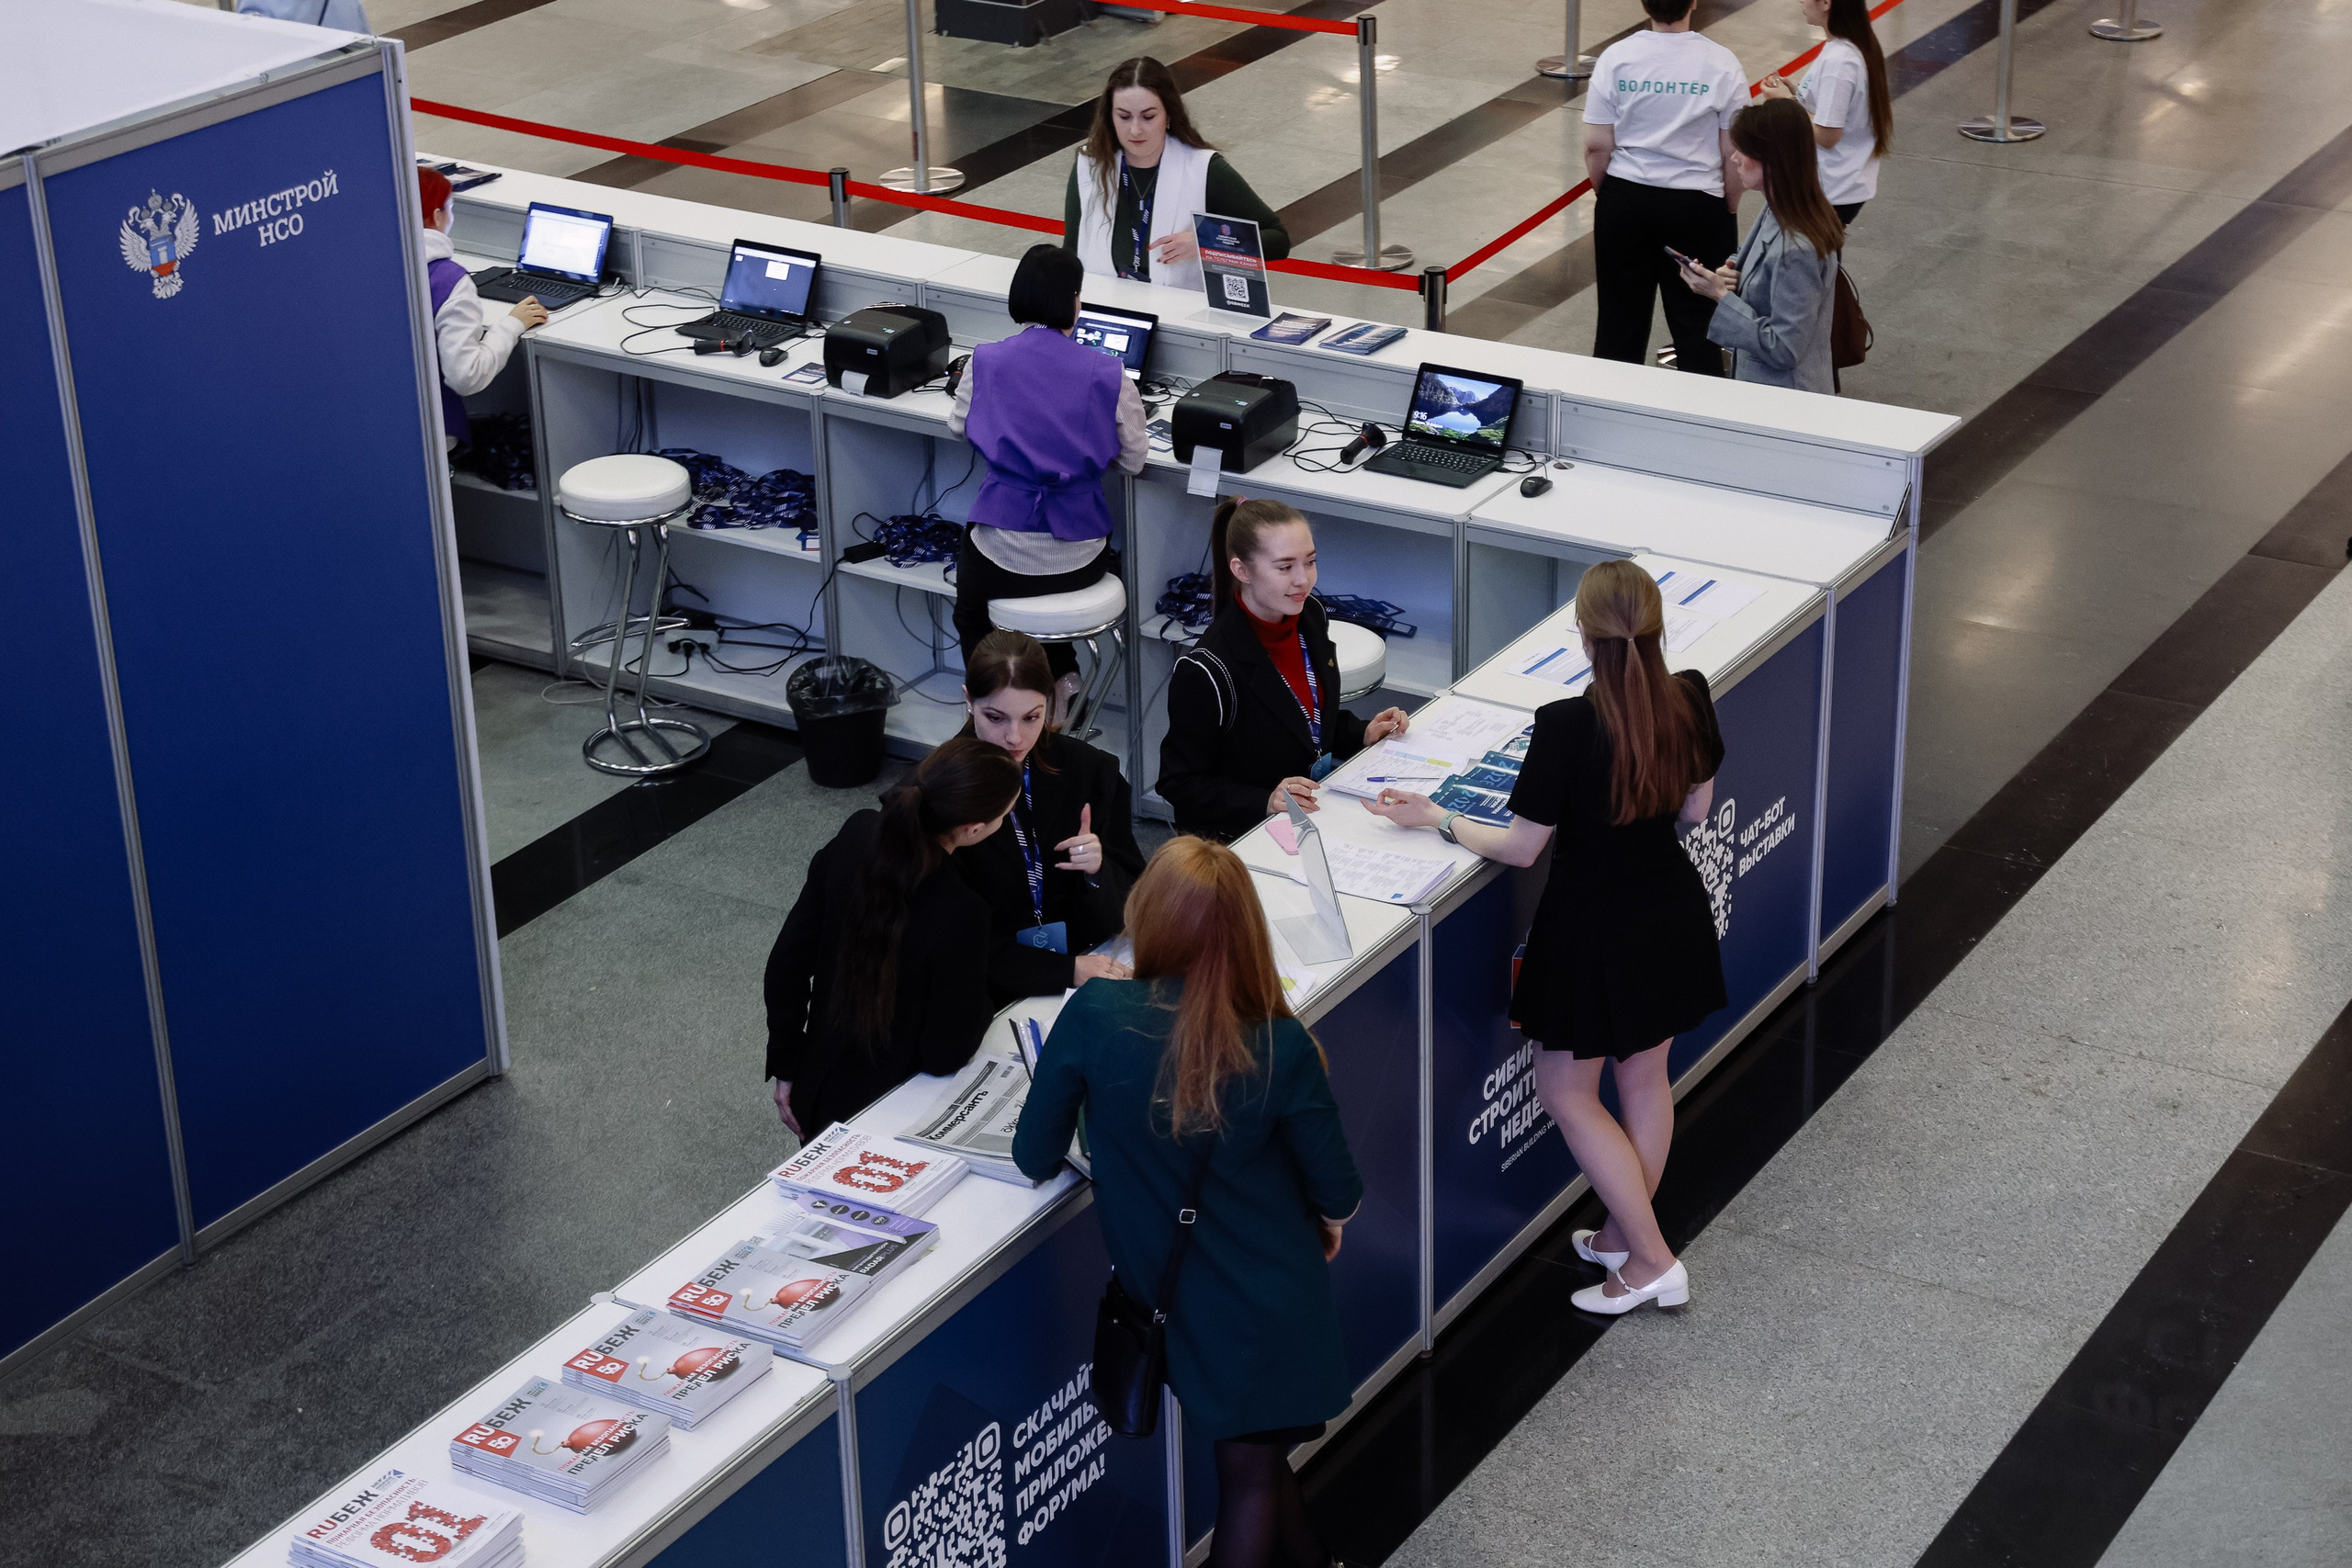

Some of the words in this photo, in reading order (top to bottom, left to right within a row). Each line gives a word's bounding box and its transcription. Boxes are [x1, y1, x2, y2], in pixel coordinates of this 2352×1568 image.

[1619, 80, 1710, 96] ВОЛОНТЁР
[212, 169, 339, 235] МИНСТРОЙ
[258, 213, 304, 247] НСО
[1738, 812, 1795, 878] ВЫСТАВКИ
[1740, 795, 1786, 847] ЧАТ-БОТ
[926, 1090, 989, 1141] Коммерсантъ
[1469, 1067, 1536, 1145] СТРОИТ
[1501, 1096, 1544, 1149] НЕДЕ
[1500, 1146, 1523, 1173] SIBERIAN
[1523, 1126, 1547, 1152] BUILDING
[777, 1297, 820, 1329] ПРЕДЕЛ
[817, 1273, 850, 1300] РИСКА
[672, 1369, 718, 1401] ПРЕДЕЛ
[716, 1342, 752, 1371] РИСКА
[1012, 1362, 1093, 1449] СКАЧАЙ
[567, 1442, 615, 1475] ПРЕДЕЛ
[611, 1413, 649, 1443] РИСКА
[1014, 1401, 1098, 1484] МОБИЛЬ
[1016, 1419, 1112, 1517] ПРИЛОЖЕ
[335, 1519, 376, 1550] РЕФОРМА
[373, 1479, 429, 1525] НОРМАТИВОВ
[1017, 1452, 1105, 1546] ФОРУМА!
[326, 1517, 366, 1545] ПОЖАРНАЯ
